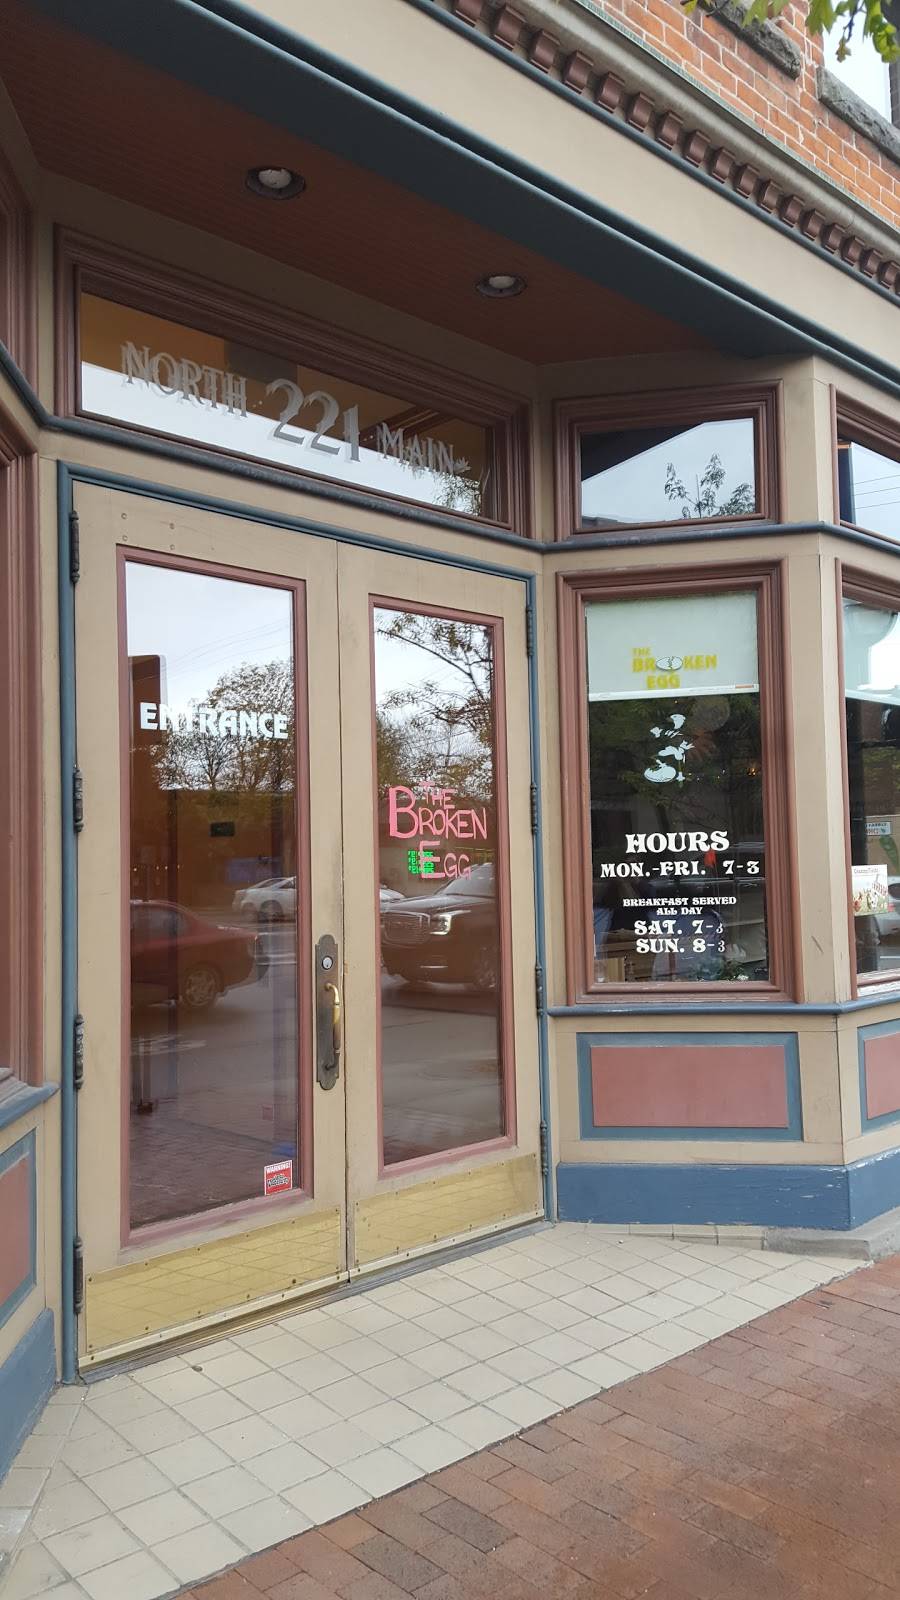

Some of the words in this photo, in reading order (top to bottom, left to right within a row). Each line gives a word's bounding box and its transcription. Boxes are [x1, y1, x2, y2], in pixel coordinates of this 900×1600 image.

[119, 341, 248, 418] NORTH
[265, 377, 361, 463] 221
[632, 648, 650, 656] THE
[646, 674, 681, 690] EGG
[139, 701, 289, 740] ENTRANCE
[418, 780, 457, 810] THE
[388, 785, 488, 840] BROKEN
[625, 831, 730, 854] HOURS
[419, 840, 472, 880] EGG
[600, 859, 706, 878] MON.-FRI.
[623, 898, 689, 907] BREAKFAST
[692, 896, 737, 905] SERVED
[656, 906, 678, 915] ALL
[681, 906, 703, 915] DAY
[633, 919, 683, 935] SAT.
[636, 938, 685, 954] SUN.
[692, 938, 726, 954] 8-3
